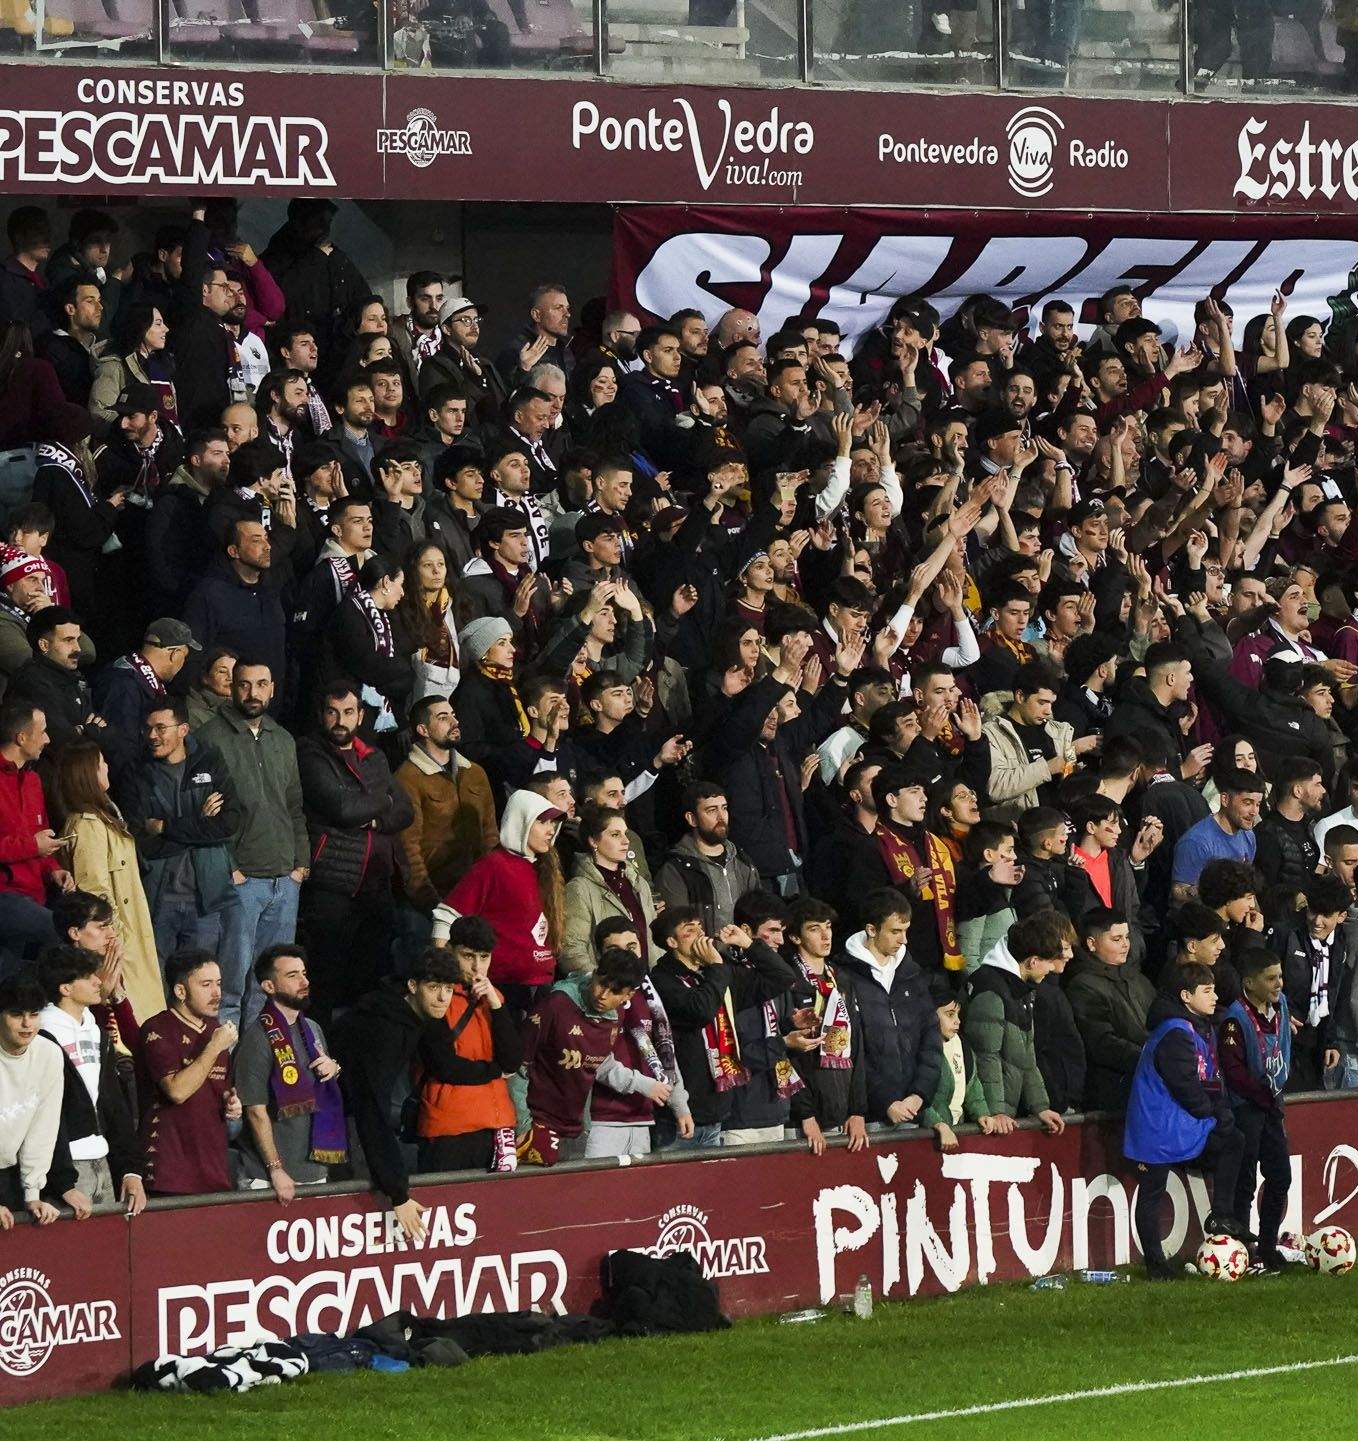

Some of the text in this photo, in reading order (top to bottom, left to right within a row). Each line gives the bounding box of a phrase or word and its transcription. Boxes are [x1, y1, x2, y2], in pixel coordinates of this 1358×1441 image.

[77, 78, 244, 107] CONSERVAS
[377, 129, 472, 154] PESCAMAR
[879, 134, 1129, 168] Pontevedra Viva Radio
[658, 1203, 709, 1230] CONSERVAS
[0, 1267, 51, 1291] ONSERVAS
